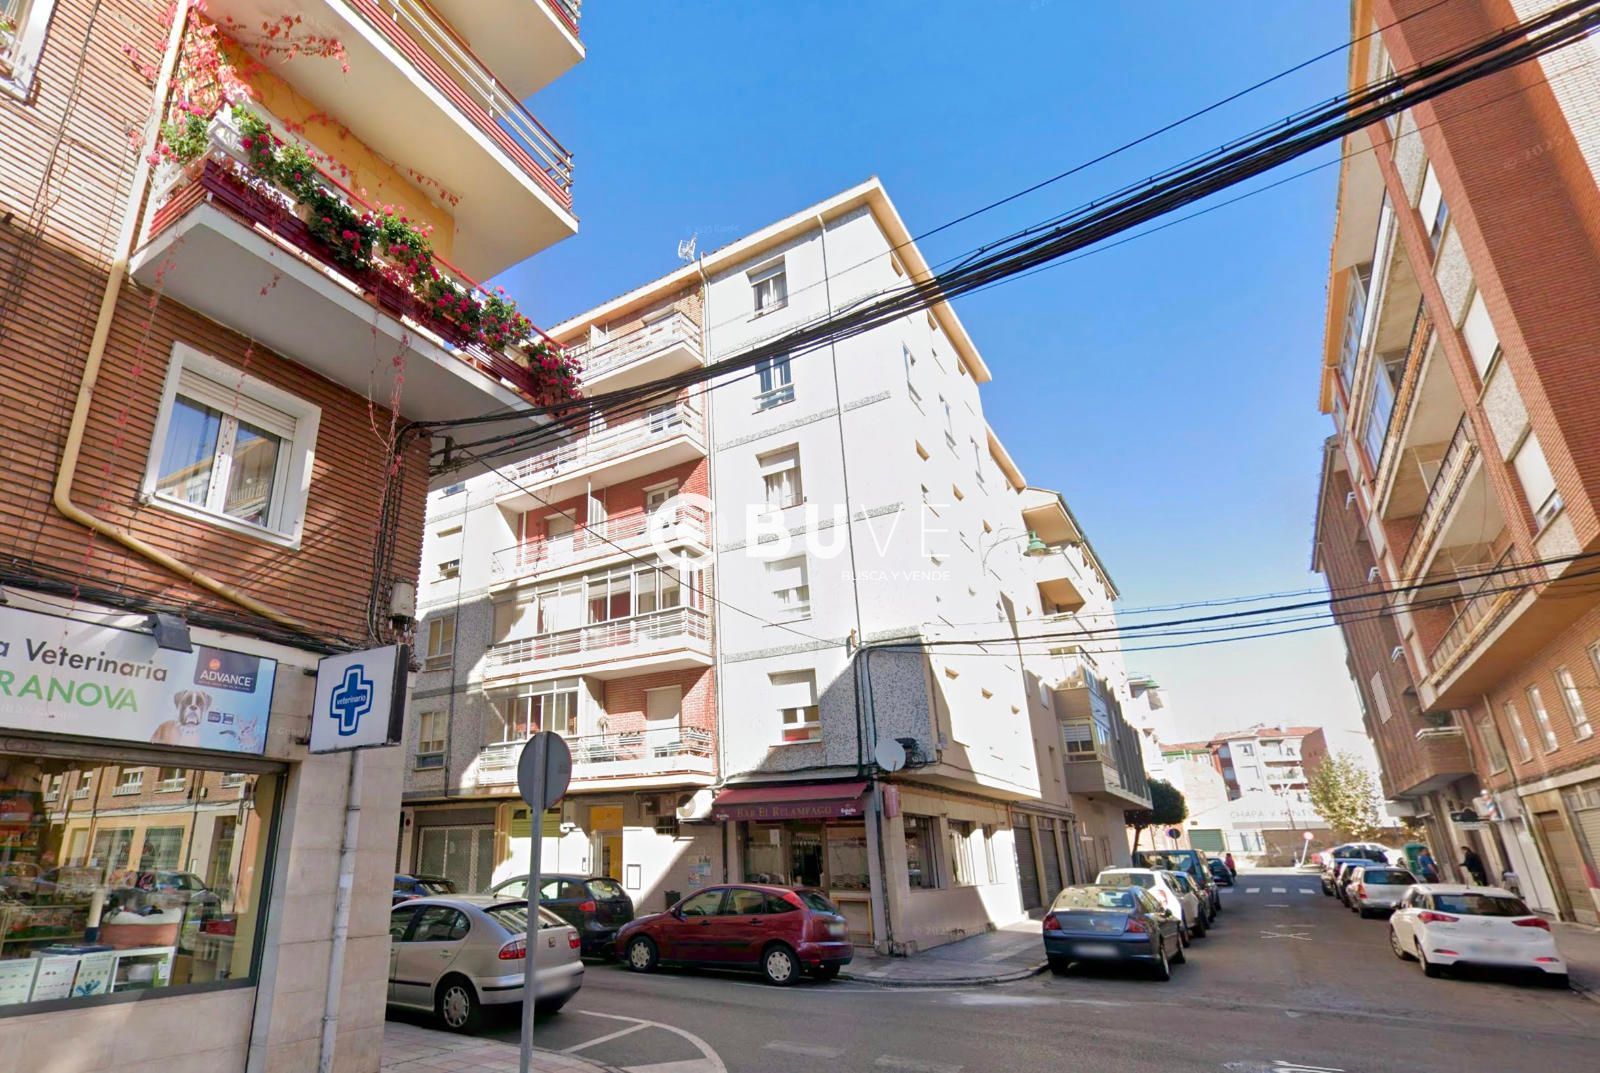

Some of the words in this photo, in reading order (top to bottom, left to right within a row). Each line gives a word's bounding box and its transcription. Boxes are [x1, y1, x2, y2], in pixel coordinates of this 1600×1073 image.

[26, 638, 168, 682] Veterinaria
[200, 670, 252, 687] ADVANCE
[336, 694, 367, 705] veterinario
